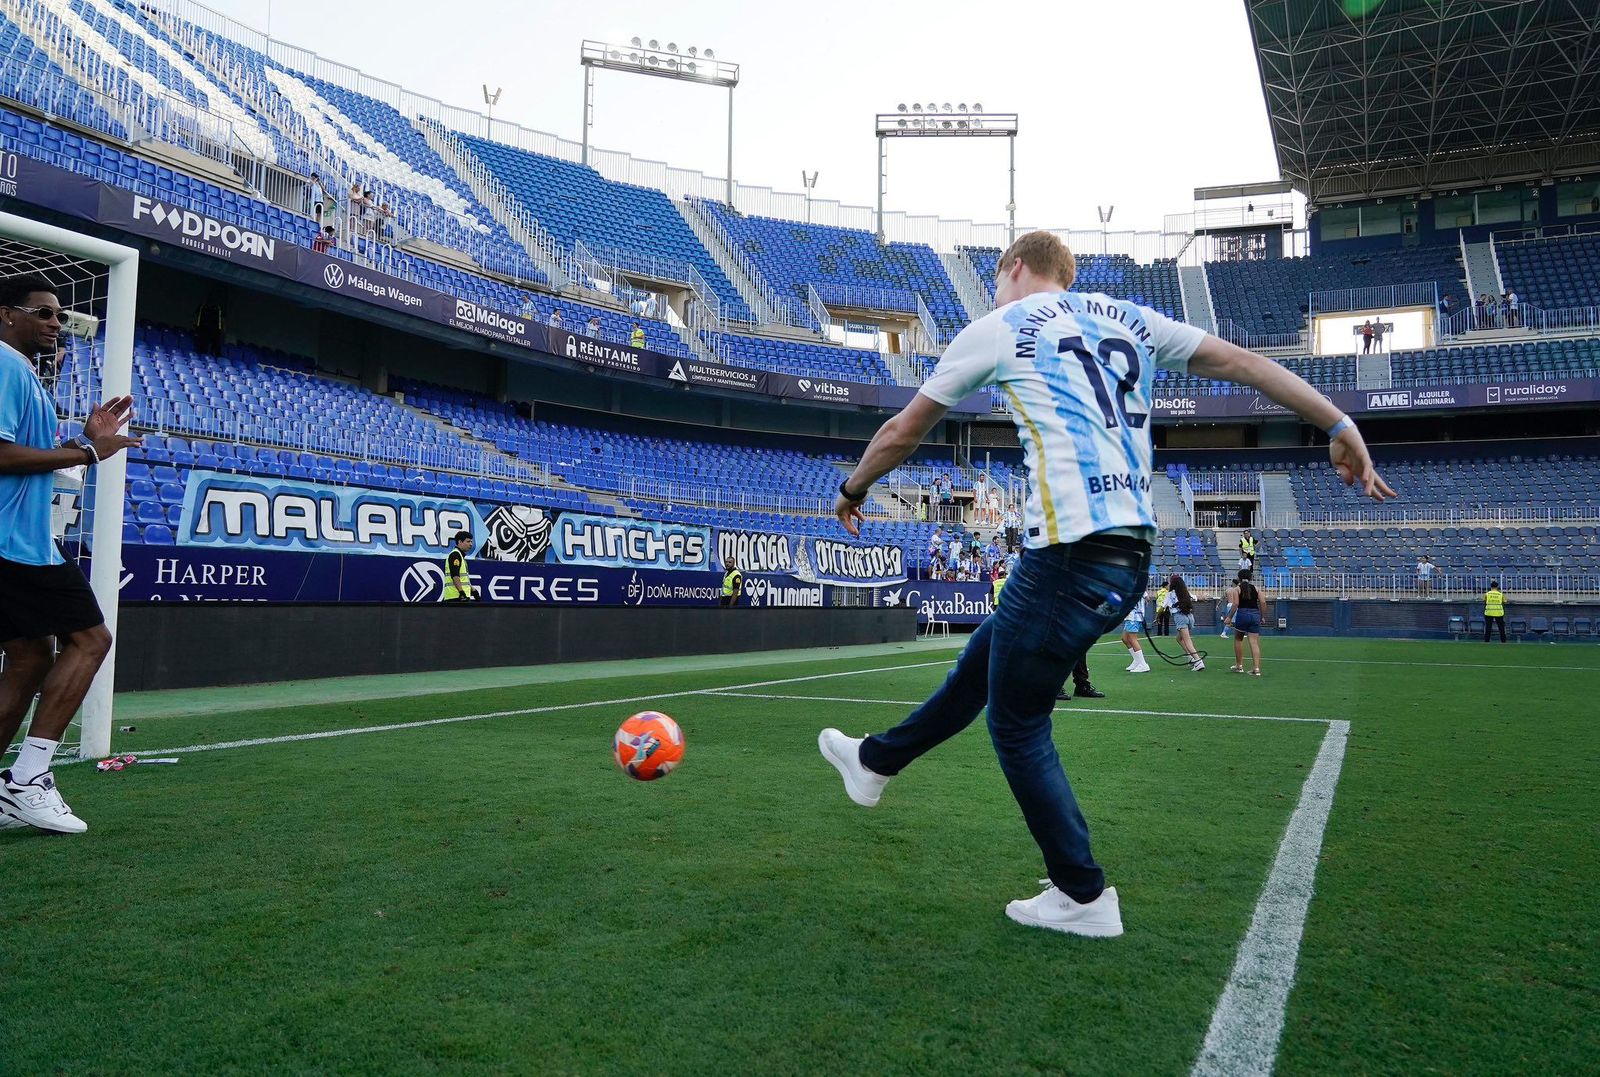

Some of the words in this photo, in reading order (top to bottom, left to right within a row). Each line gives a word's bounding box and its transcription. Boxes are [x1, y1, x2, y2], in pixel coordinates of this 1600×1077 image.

[347, 274, 386, 297] Málaga
[387, 286, 422, 307] Wagen
[456, 320, 474, 331] MEJOR
[474, 326, 492, 337] ALIADO
[492, 331, 505, 341] PARA
[513, 337, 531, 347] TALLER
[476, 307, 525, 336] Málaga
[1015, 306, 1057, 358] MANU
[1086, 299, 1156, 357] MOLINA
[580, 341, 639, 365] RÉNTAME
[688, 364, 749, 381] MULTISERVICIOS
[1057, 335, 1148, 429] 12
[813, 383, 850, 396] vithas
[1369, 393, 1409, 408] AMG
[1413, 397, 1456, 406] MAQUINARIA
[1418, 391, 1450, 399] ALQUILER
[1504, 384, 1567, 396] ruralidays
[1154, 398, 1196, 409] DisOfic
[195, 488, 470, 547] MALAKA
[564, 523, 703, 563] HINCHAS
[767, 583, 823, 606] hummel
[906, 590, 994, 614] CaixaBank
